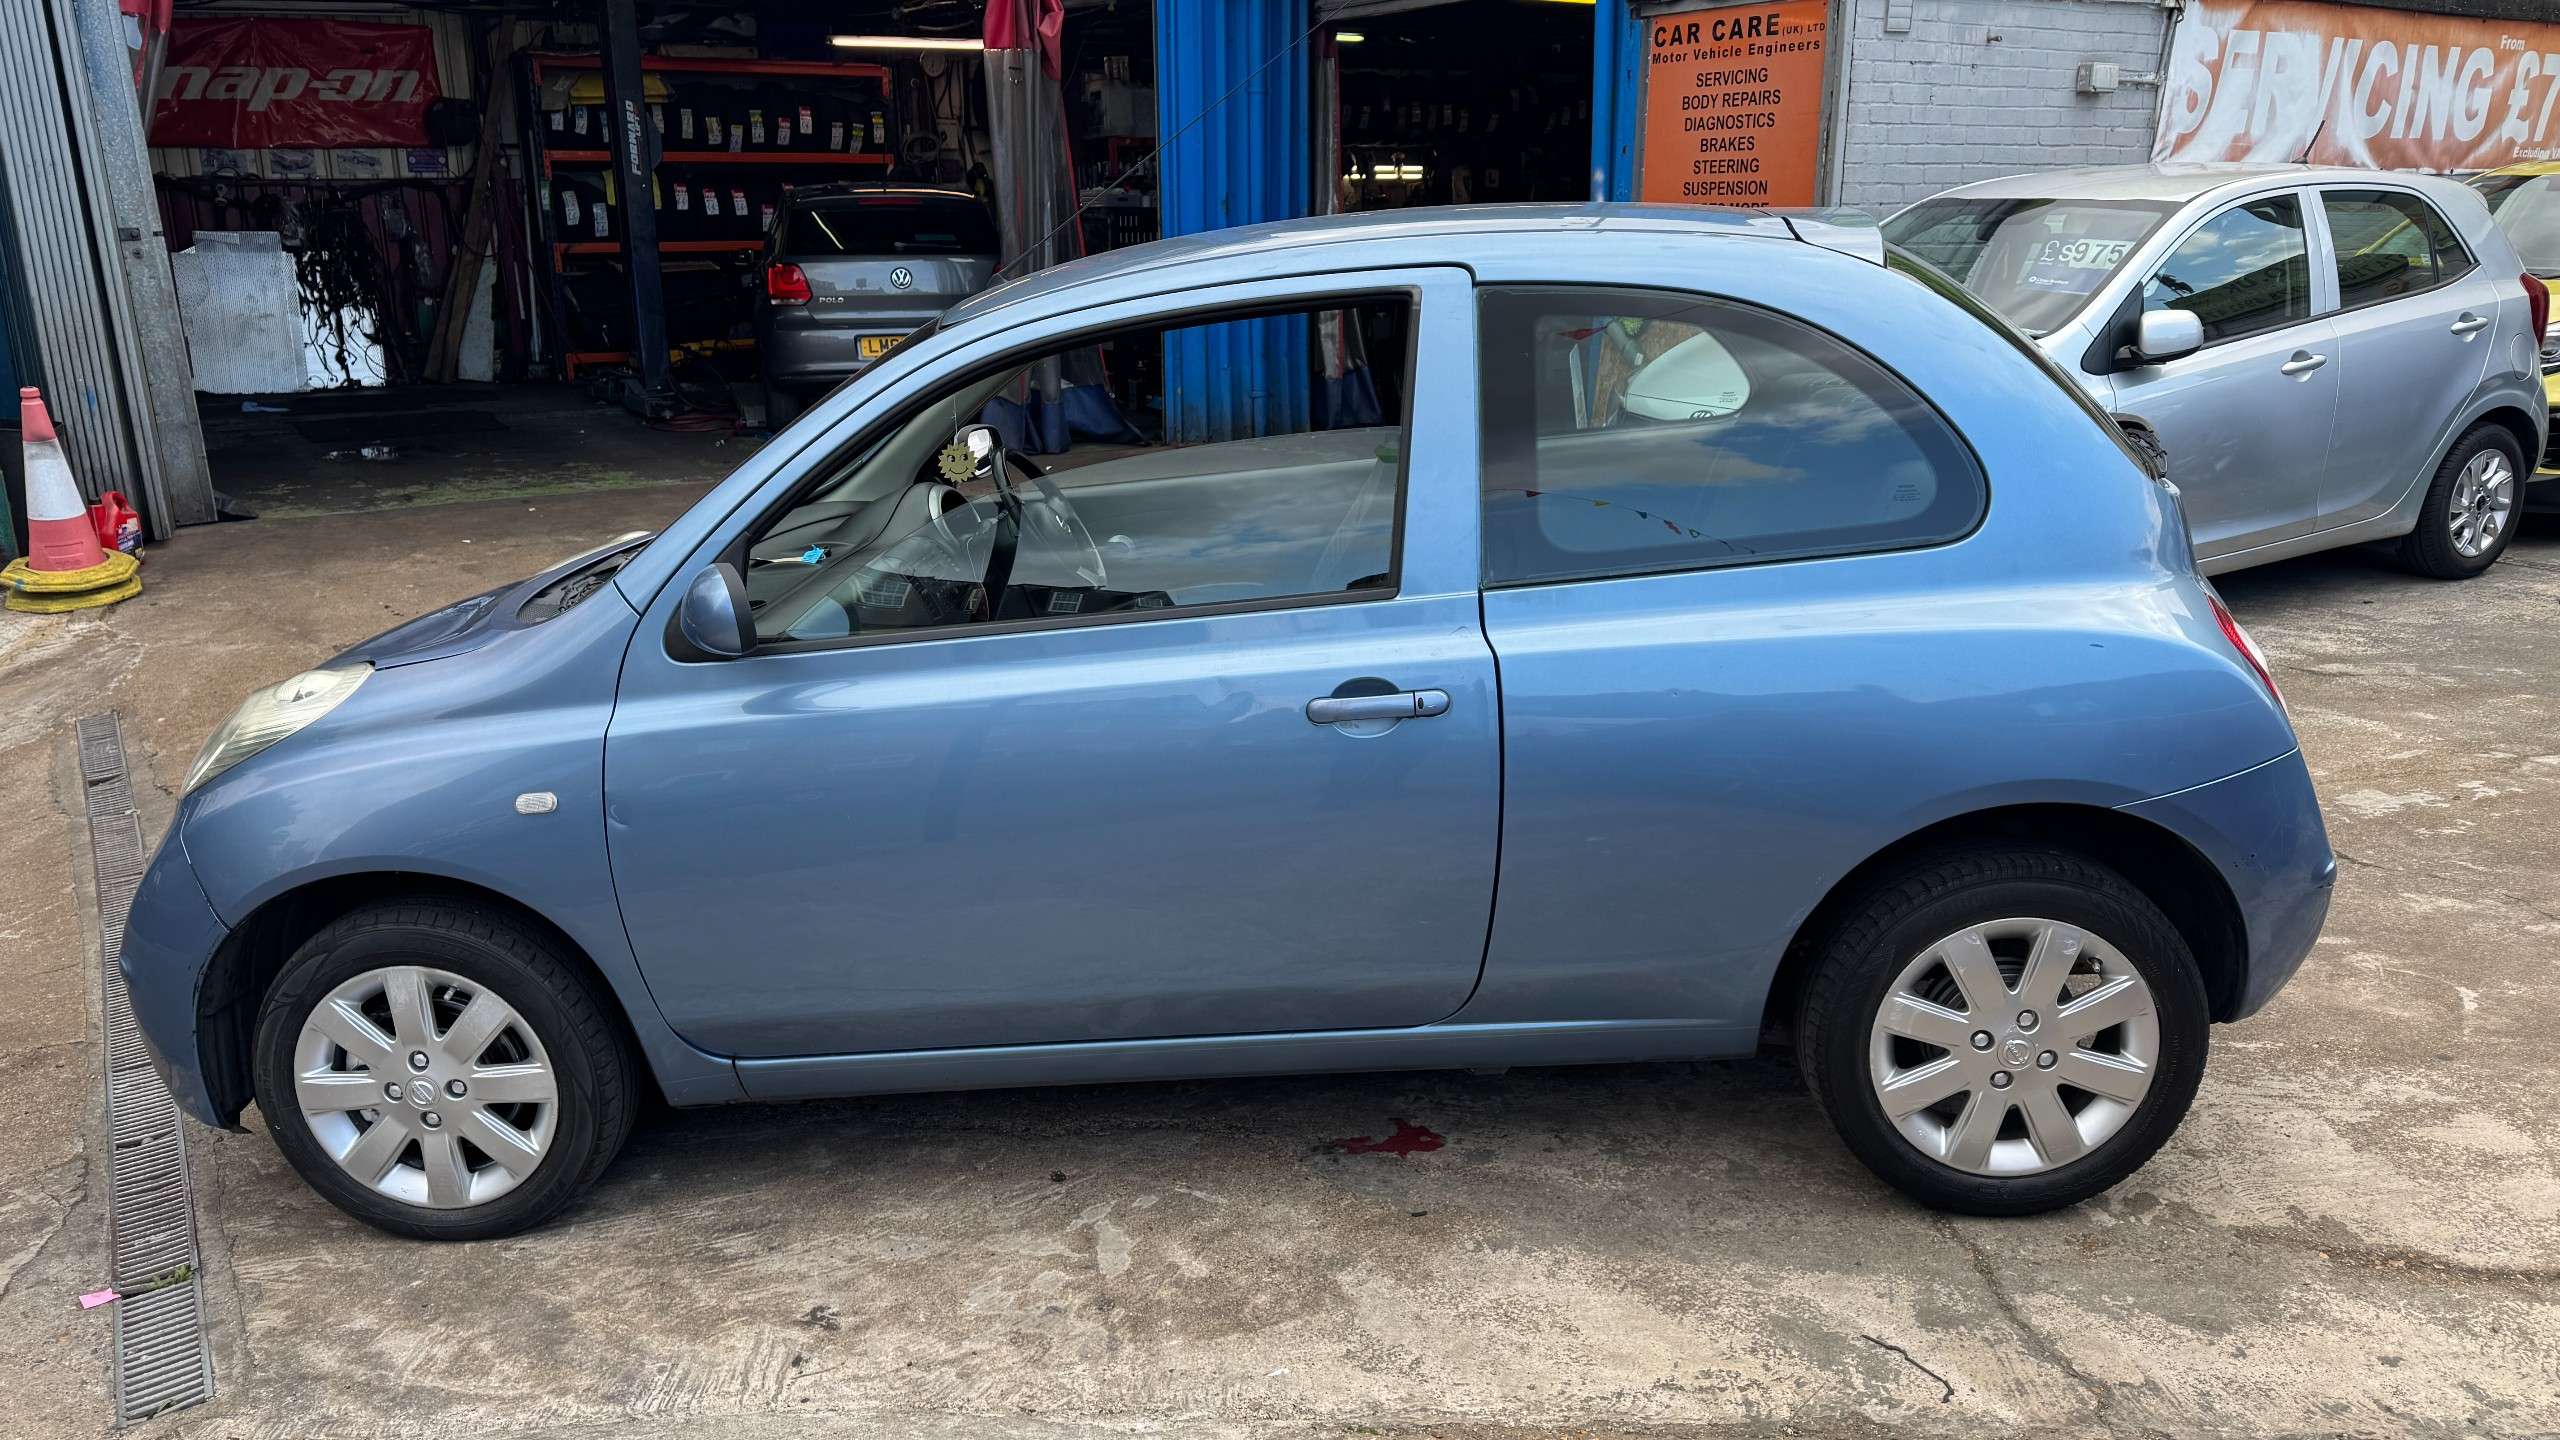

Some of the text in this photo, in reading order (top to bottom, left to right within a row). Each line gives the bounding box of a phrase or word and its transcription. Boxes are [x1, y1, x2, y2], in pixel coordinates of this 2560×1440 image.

[1654, 13, 1826, 48] CAR CARE (UK) LTD
[1652, 40, 1820, 64] Motor Vehicle Engineers
[2500, 34, 2526, 50] From
[1696, 67, 1769, 88] SERVICING
[2168, 26, 2495, 143] SERVICING
[154, 65, 420, 112] nap-on
[1682, 89, 1782, 111] BODY REPAIRS
[1684, 112, 1776, 132] DIAGNOSTICS
[625, 99, 642, 176] FORWARD
[1700, 136, 1755, 153] BRAKES
[1693, 157, 1760, 175] STEERING
[1683, 179, 1768, 197] SUSPENSION
[819, 296, 845, 304] POLO
